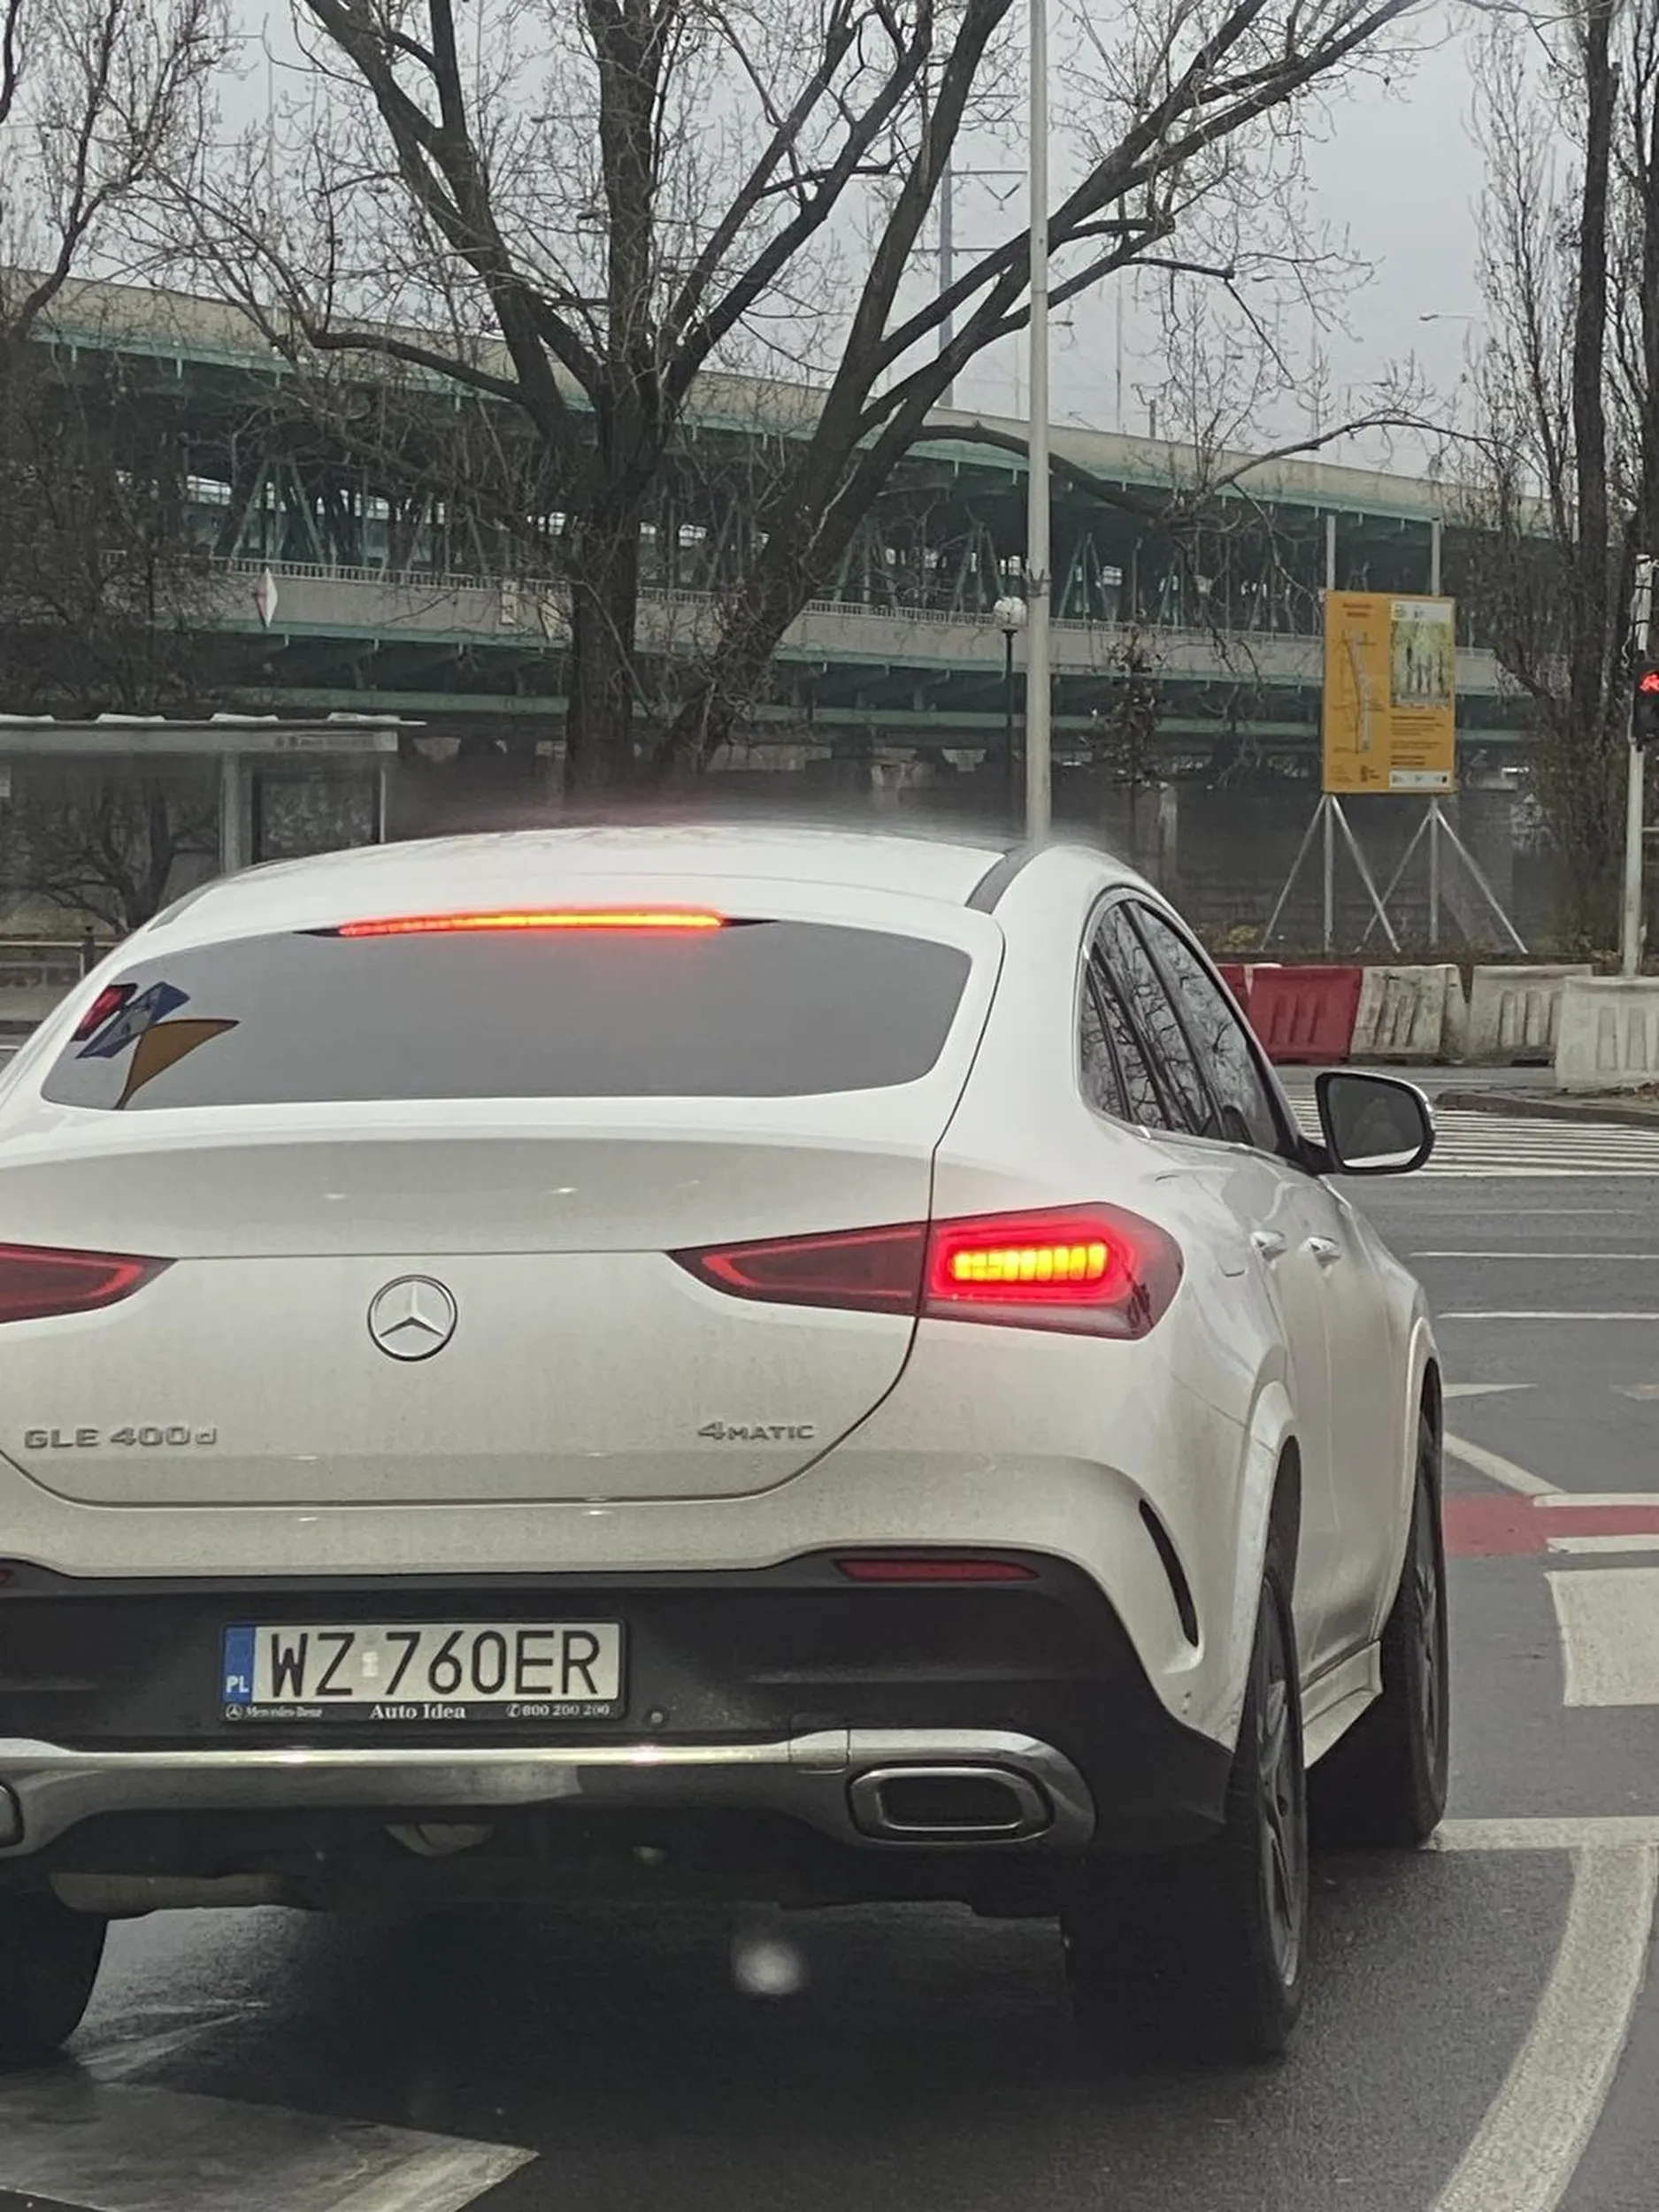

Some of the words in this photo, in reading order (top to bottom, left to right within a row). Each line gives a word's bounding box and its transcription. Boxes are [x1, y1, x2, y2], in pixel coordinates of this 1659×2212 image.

[24, 1427, 99, 1448] GLE
[697, 1420, 814, 1440] 4MATIC
[271, 1631, 356, 1698] WZ
[385, 1630, 600, 1696] 760ER
[226, 1674, 250, 1694] PL
[369, 1703, 418, 1719] Auto
[423, 1702, 466, 1719] Idea
[552, 1704, 580, 1717] 200
